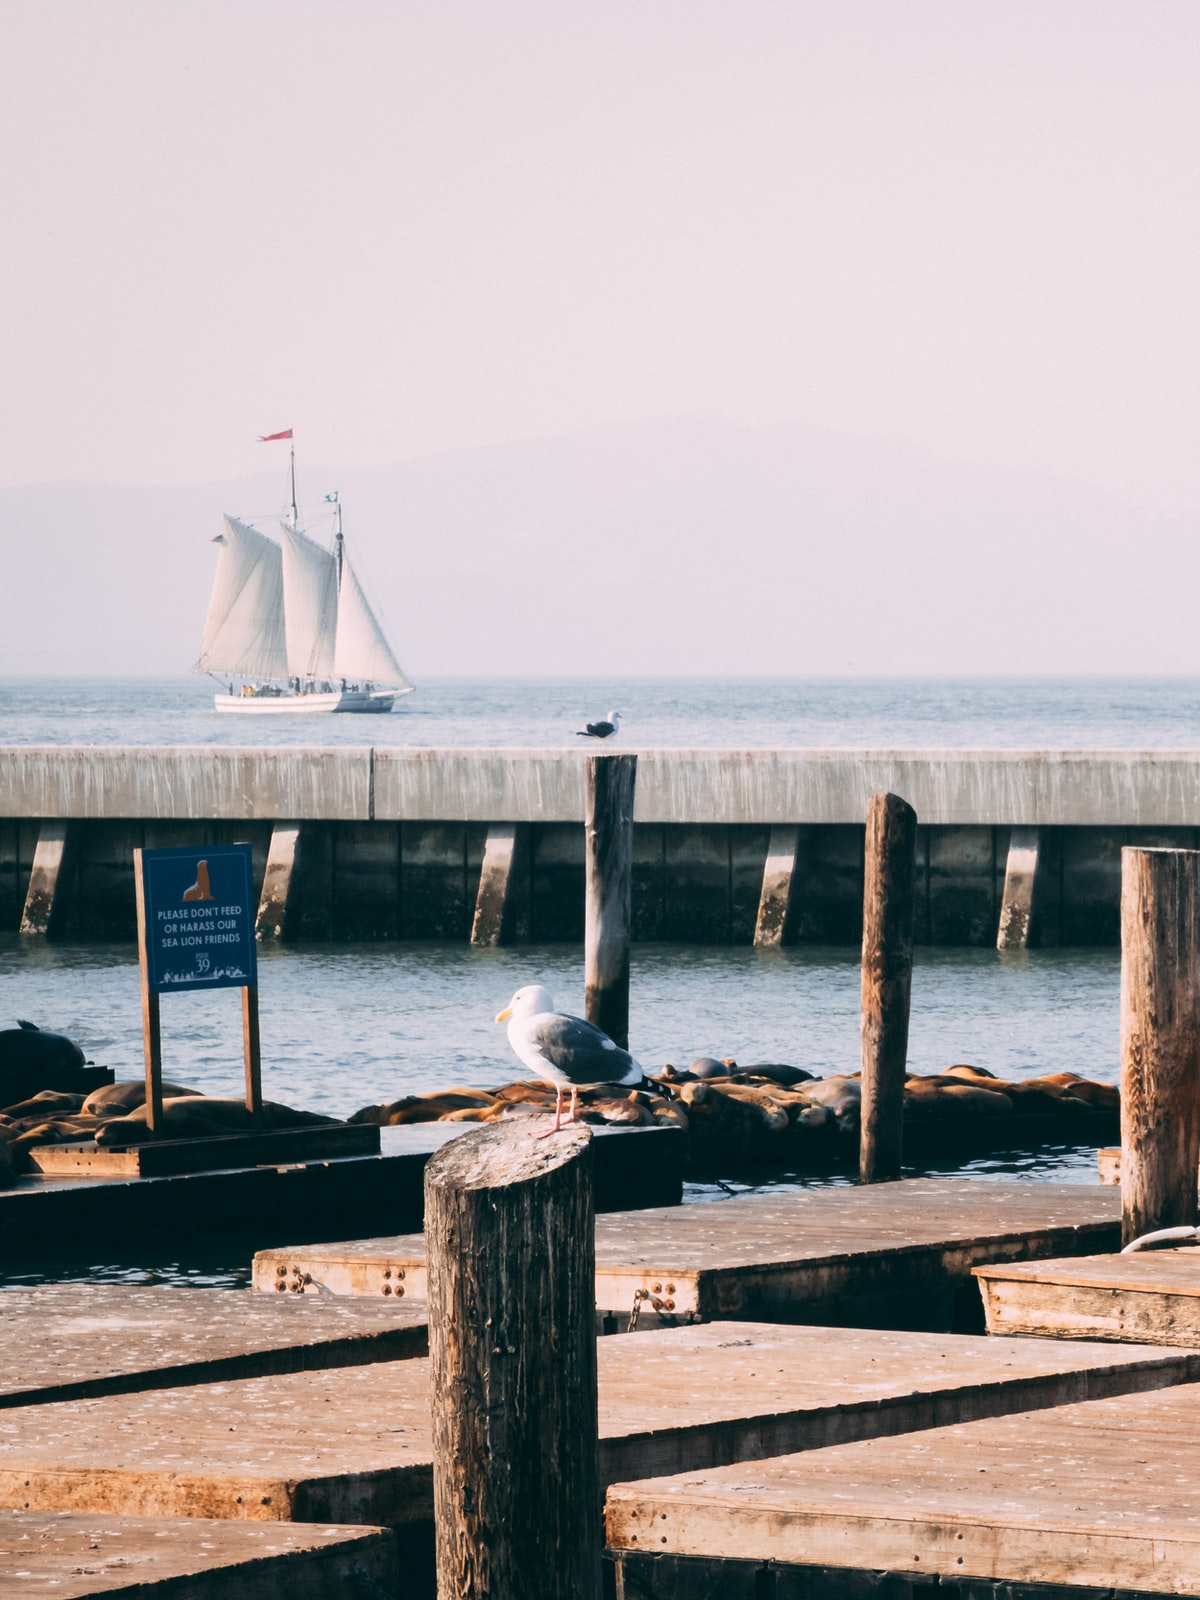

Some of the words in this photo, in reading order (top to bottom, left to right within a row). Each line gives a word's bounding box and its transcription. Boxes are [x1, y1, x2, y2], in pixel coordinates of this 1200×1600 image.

[157, 909, 189, 920] PLEASE
[191, 907, 219, 917] DON'T
[221, 906, 241, 916] FEED
[164, 924, 178, 934] OR
[180, 921, 215, 932] HARASS
[217, 919, 237, 930] OUR
[162, 938, 178, 947] SEA
[181, 936, 203, 946] LION
[204, 933, 241, 944] FRIENDS
[196, 958, 210, 973] 39
